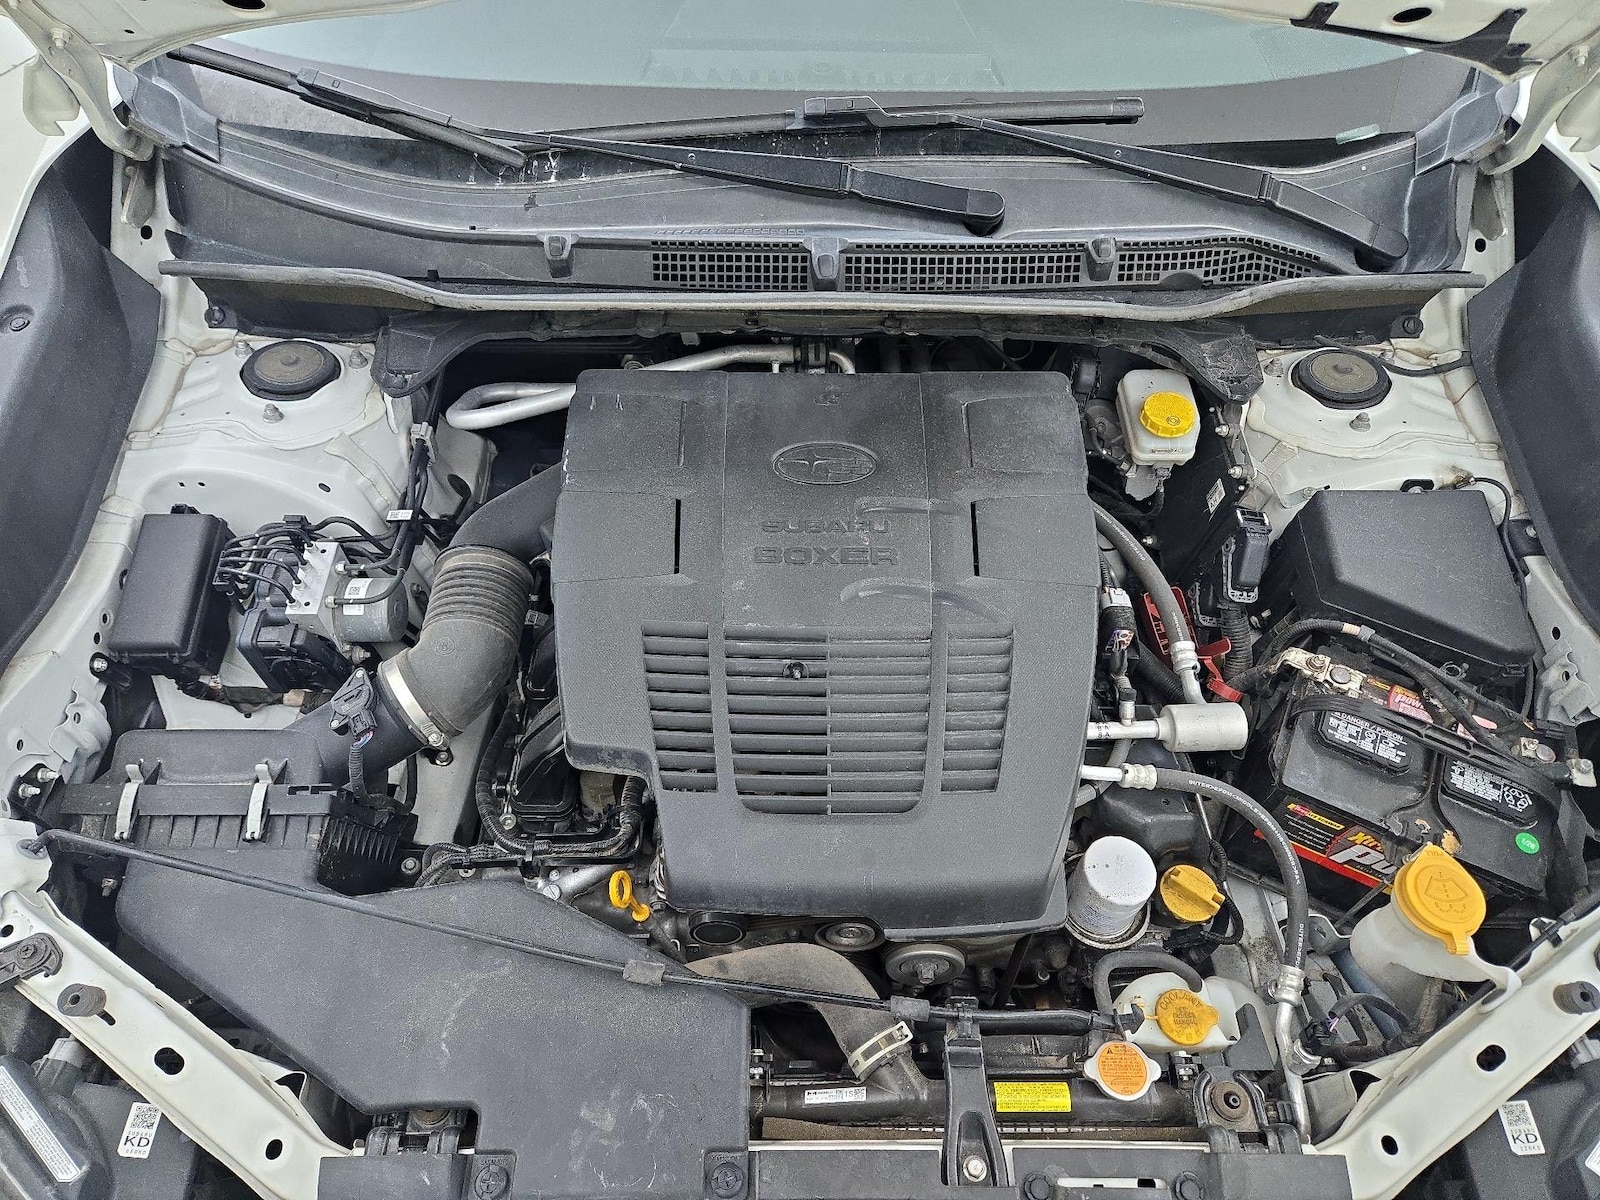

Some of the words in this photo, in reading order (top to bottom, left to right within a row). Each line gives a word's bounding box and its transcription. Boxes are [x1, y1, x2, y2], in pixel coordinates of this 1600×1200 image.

[762, 519, 890, 534] SUBARU
[754, 546, 899, 566] BOXER
[1341, 712, 1370, 728] DANGER
[1376, 727, 1404, 741] POISON
[124, 1136, 150, 1147] KD
[1512, 1133, 1538, 1144] KD
